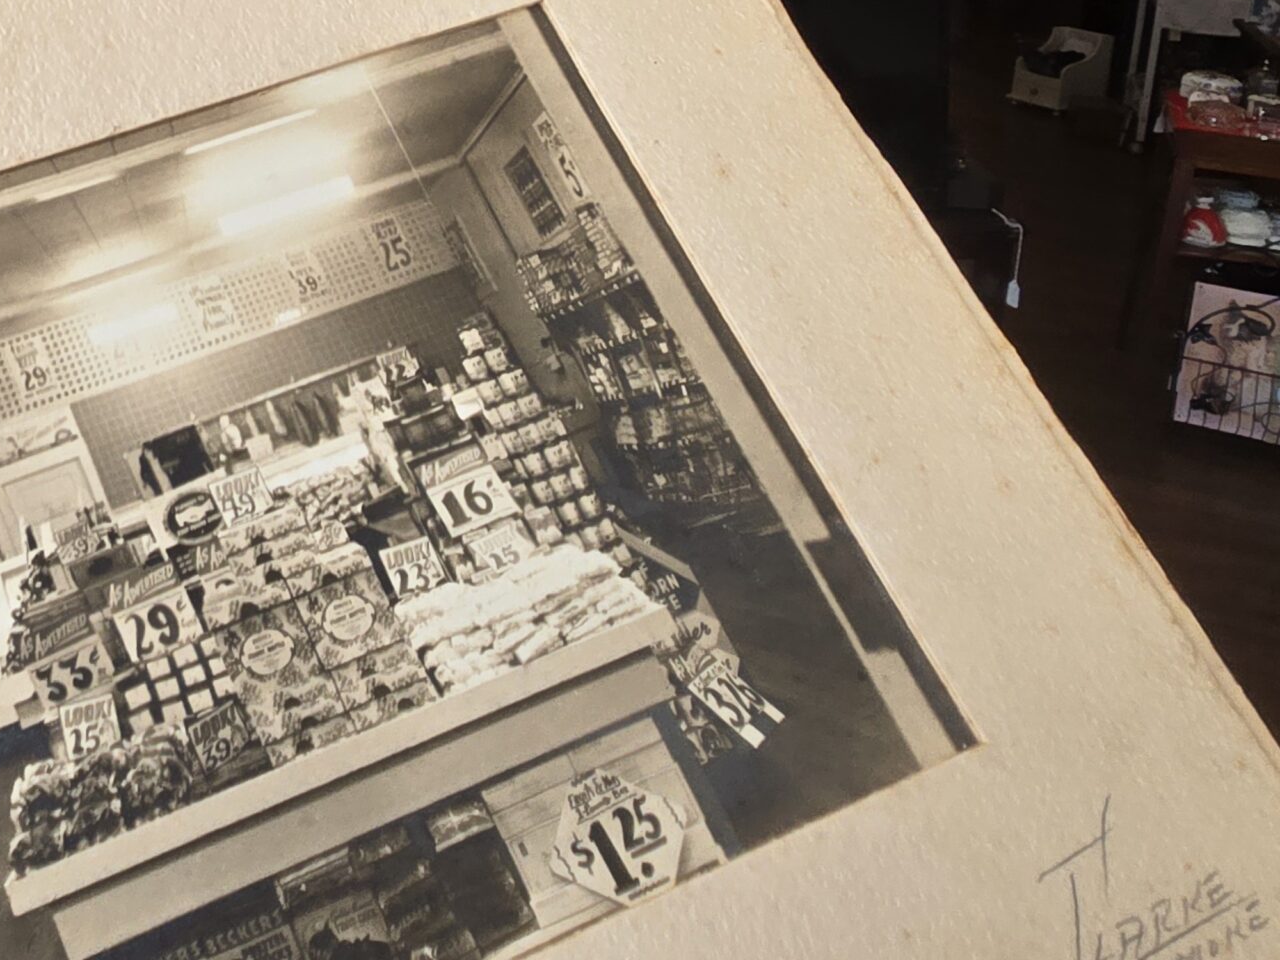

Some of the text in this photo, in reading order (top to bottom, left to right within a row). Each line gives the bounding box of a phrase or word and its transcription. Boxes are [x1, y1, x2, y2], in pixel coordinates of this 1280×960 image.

[379, 235, 412, 273] 25
[21, 366, 48, 391] 29
[387, 541, 431, 571] LOOK!
[64, 700, 113, 729] LOOK!
